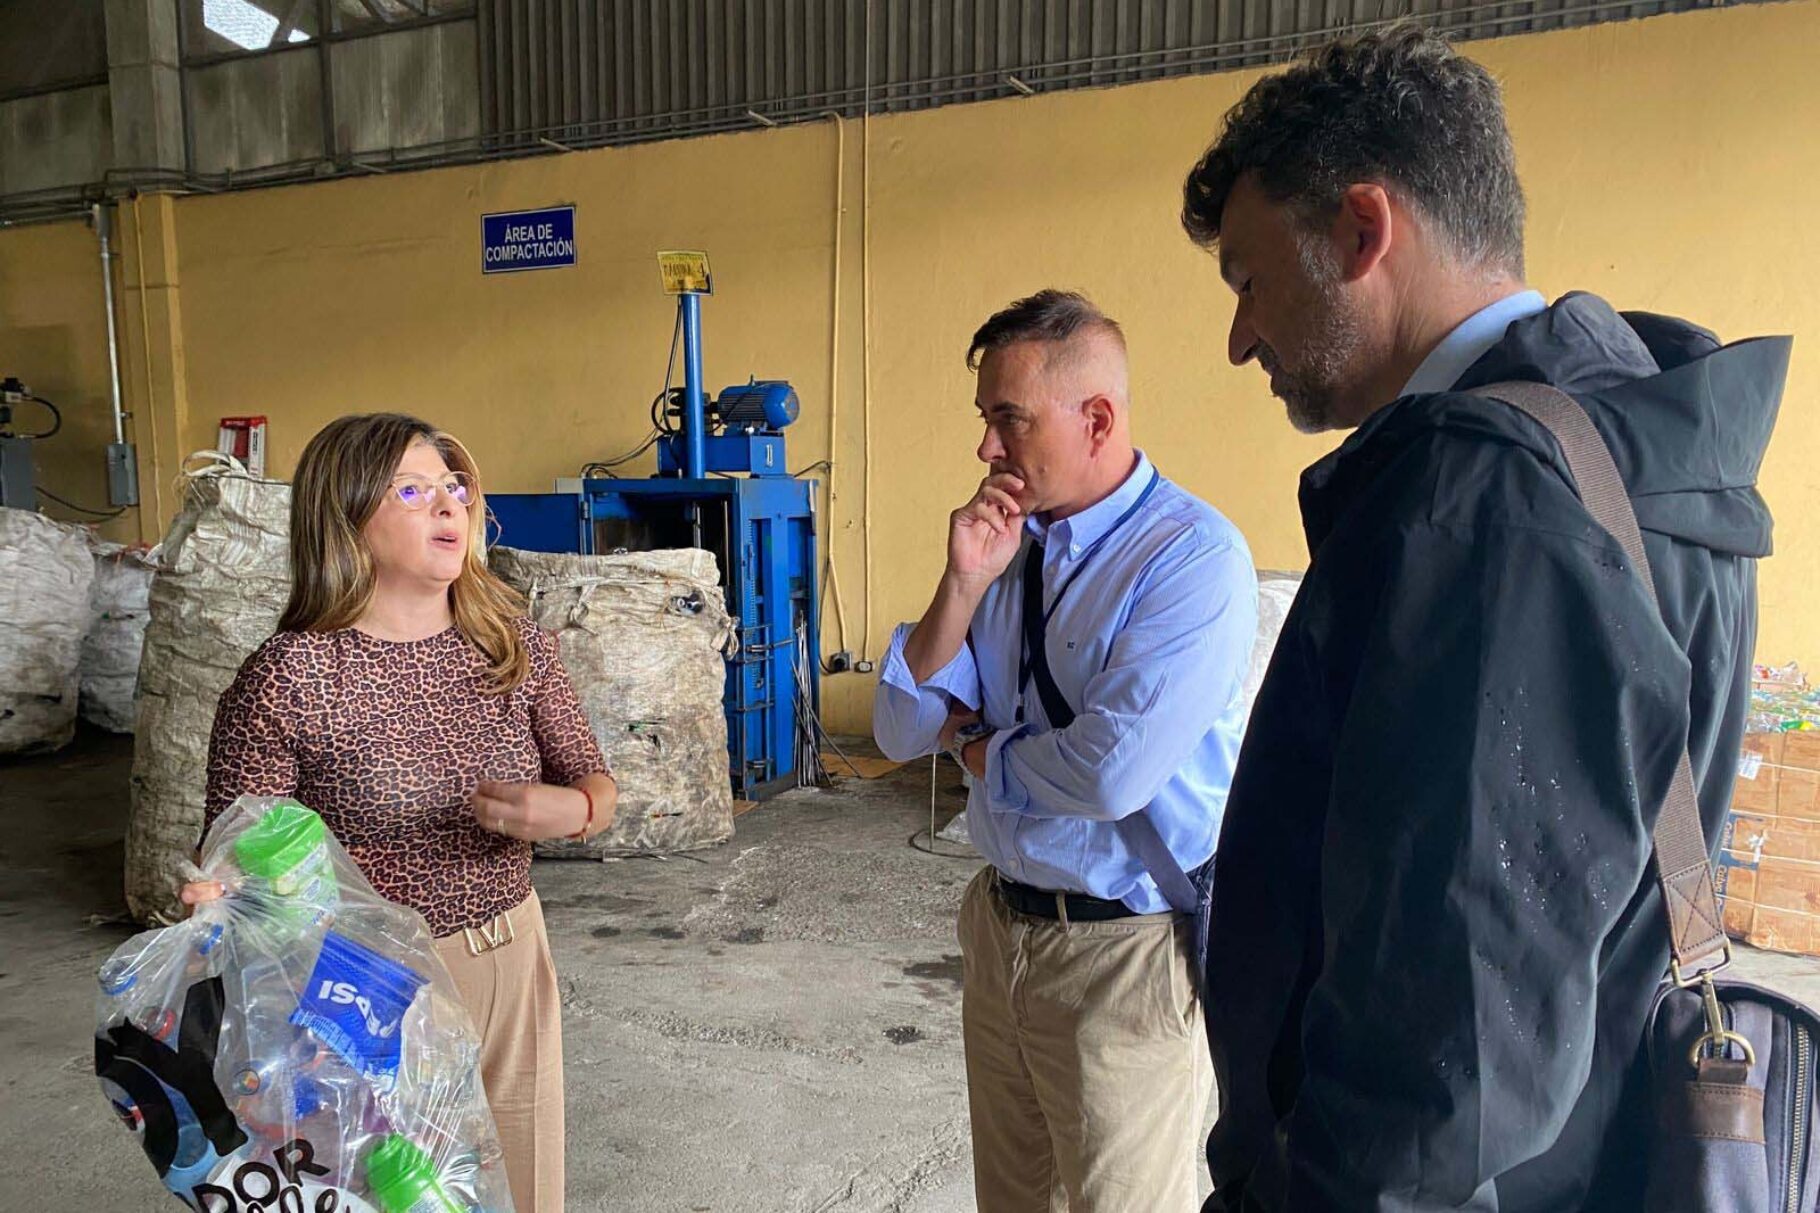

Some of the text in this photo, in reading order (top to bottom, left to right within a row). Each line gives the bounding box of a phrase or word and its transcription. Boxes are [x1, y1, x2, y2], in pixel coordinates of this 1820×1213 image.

[504, 223, 553, 243] ÁREA DE
[486, 236, 573, 262] COMPACTACIÓN
